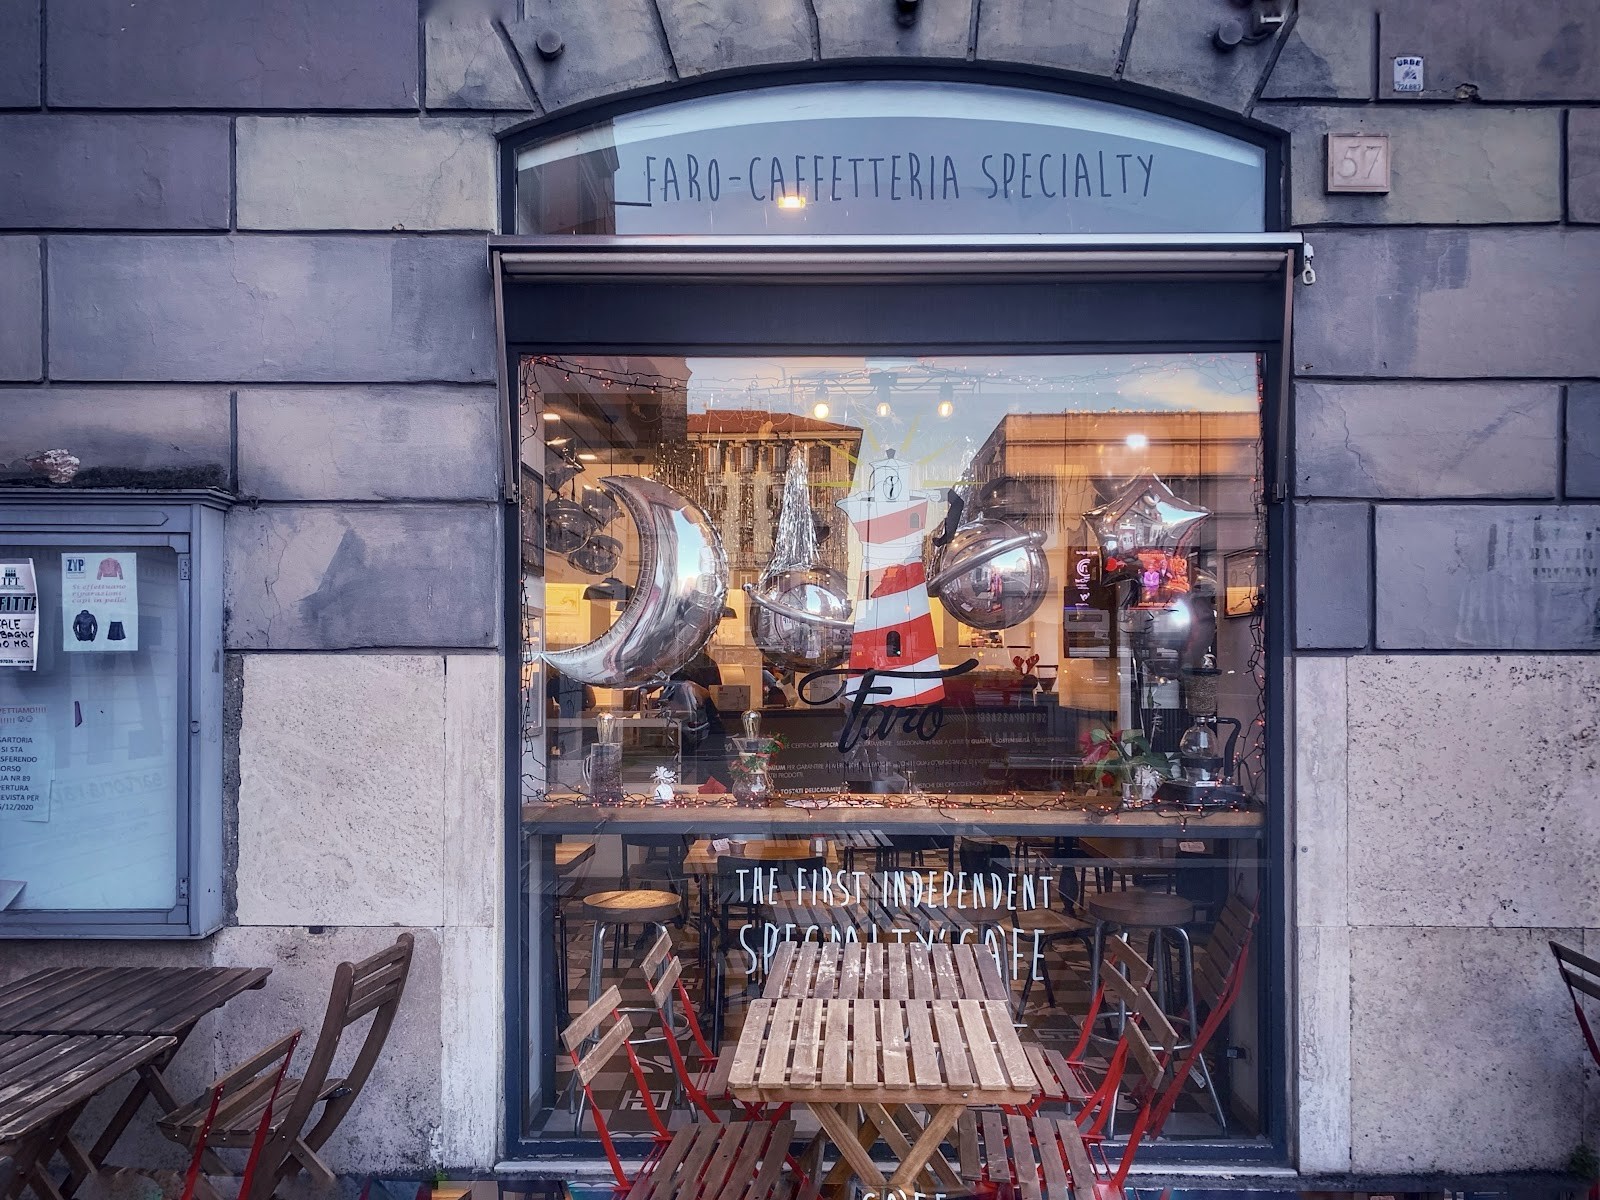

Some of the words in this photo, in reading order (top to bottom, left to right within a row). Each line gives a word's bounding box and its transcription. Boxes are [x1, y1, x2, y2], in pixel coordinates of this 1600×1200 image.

[1396, 58, 1421, 67] URBE
[646, 153, 960, 202] FARO-CAFFETTERIA
[981, 150, 1154, 199] SPECIALTY
[1337, 145, 1382, 179] 57
[1, 577, 20, 586] TFT
[67, 559, 84, 571] ZYP
[798, 658, 980, 754] Faro
[735, 866, 779, 905] THE
[797, 866, 866, 906] FIRST
[883, 870, 1054, 911] INDEPENDENT
